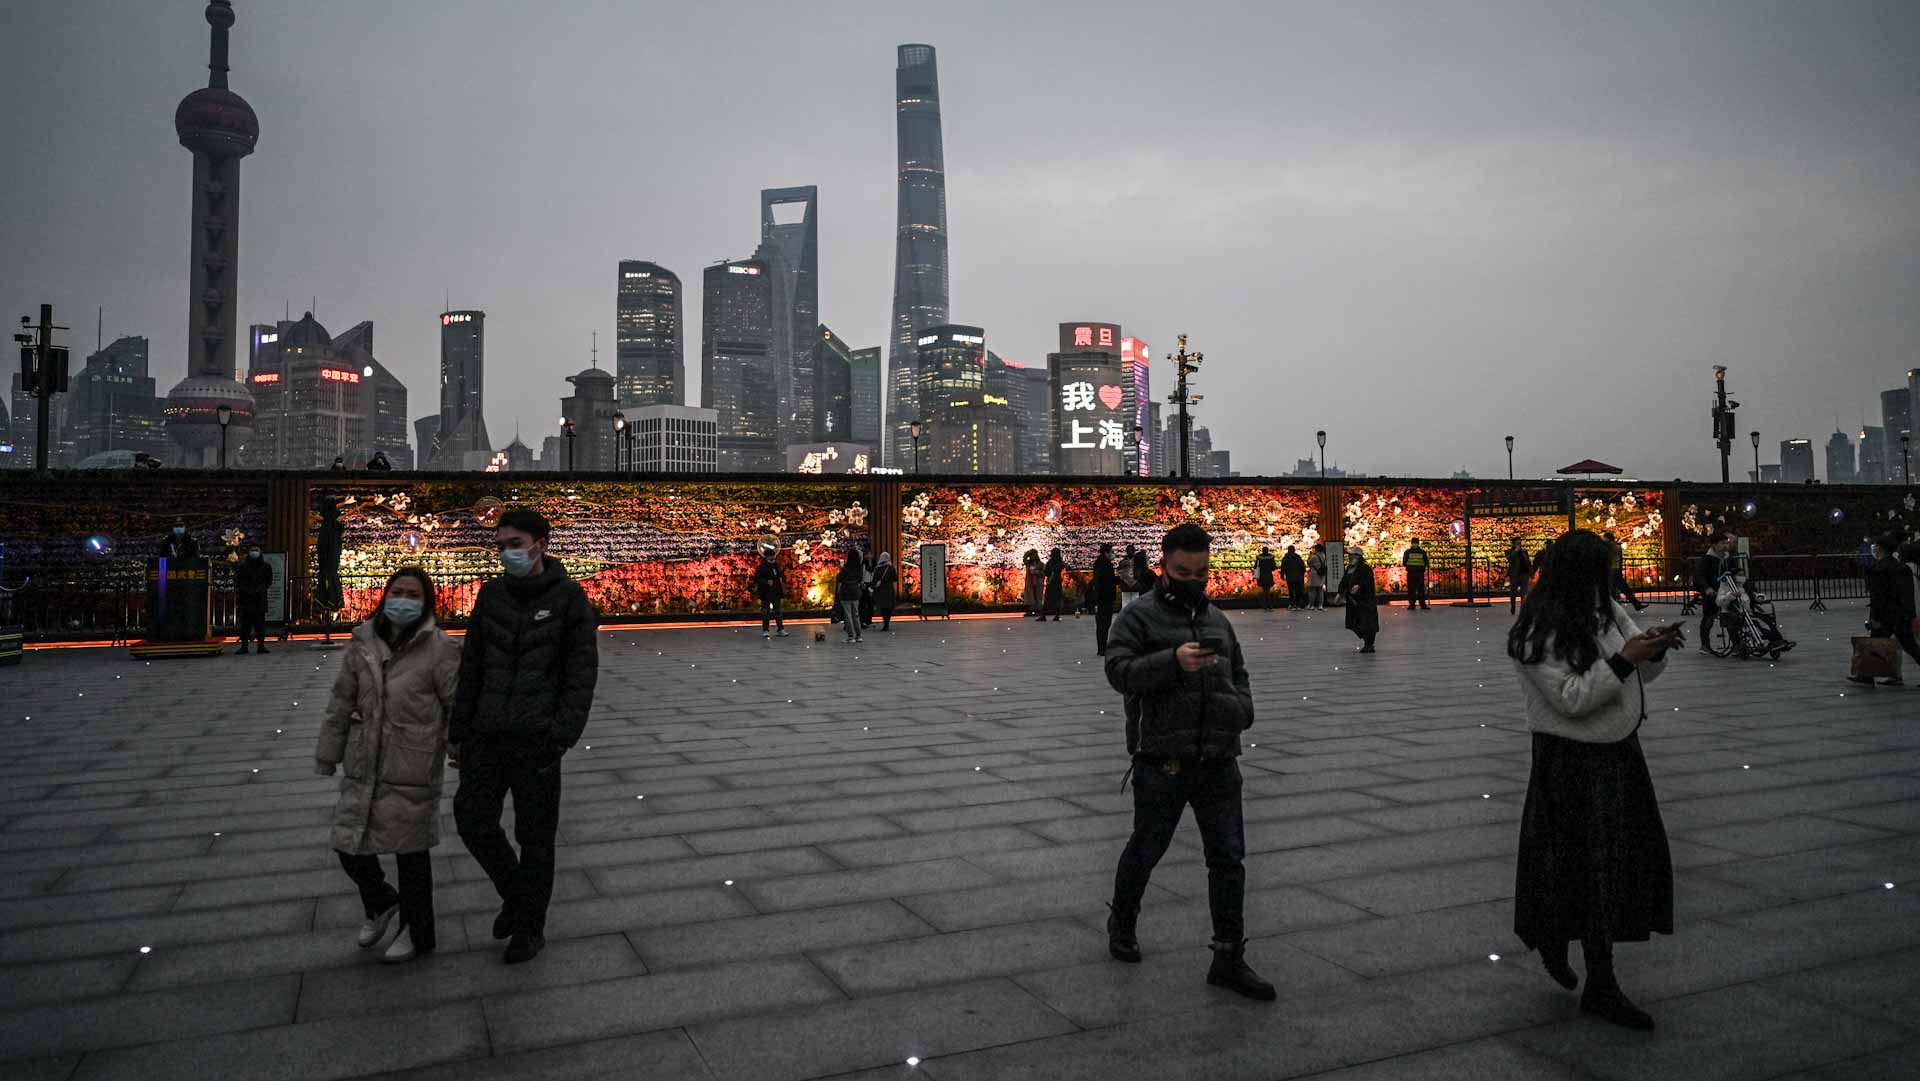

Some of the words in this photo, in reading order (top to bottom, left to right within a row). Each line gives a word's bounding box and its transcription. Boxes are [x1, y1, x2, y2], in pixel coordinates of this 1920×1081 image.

[1074, 326, 1113, 347] 震旦
[321, 368, 360, 384] 中国平安
[1061, 381, 1096, 412] 我
[1060, 418, 1124, 450] 上海
